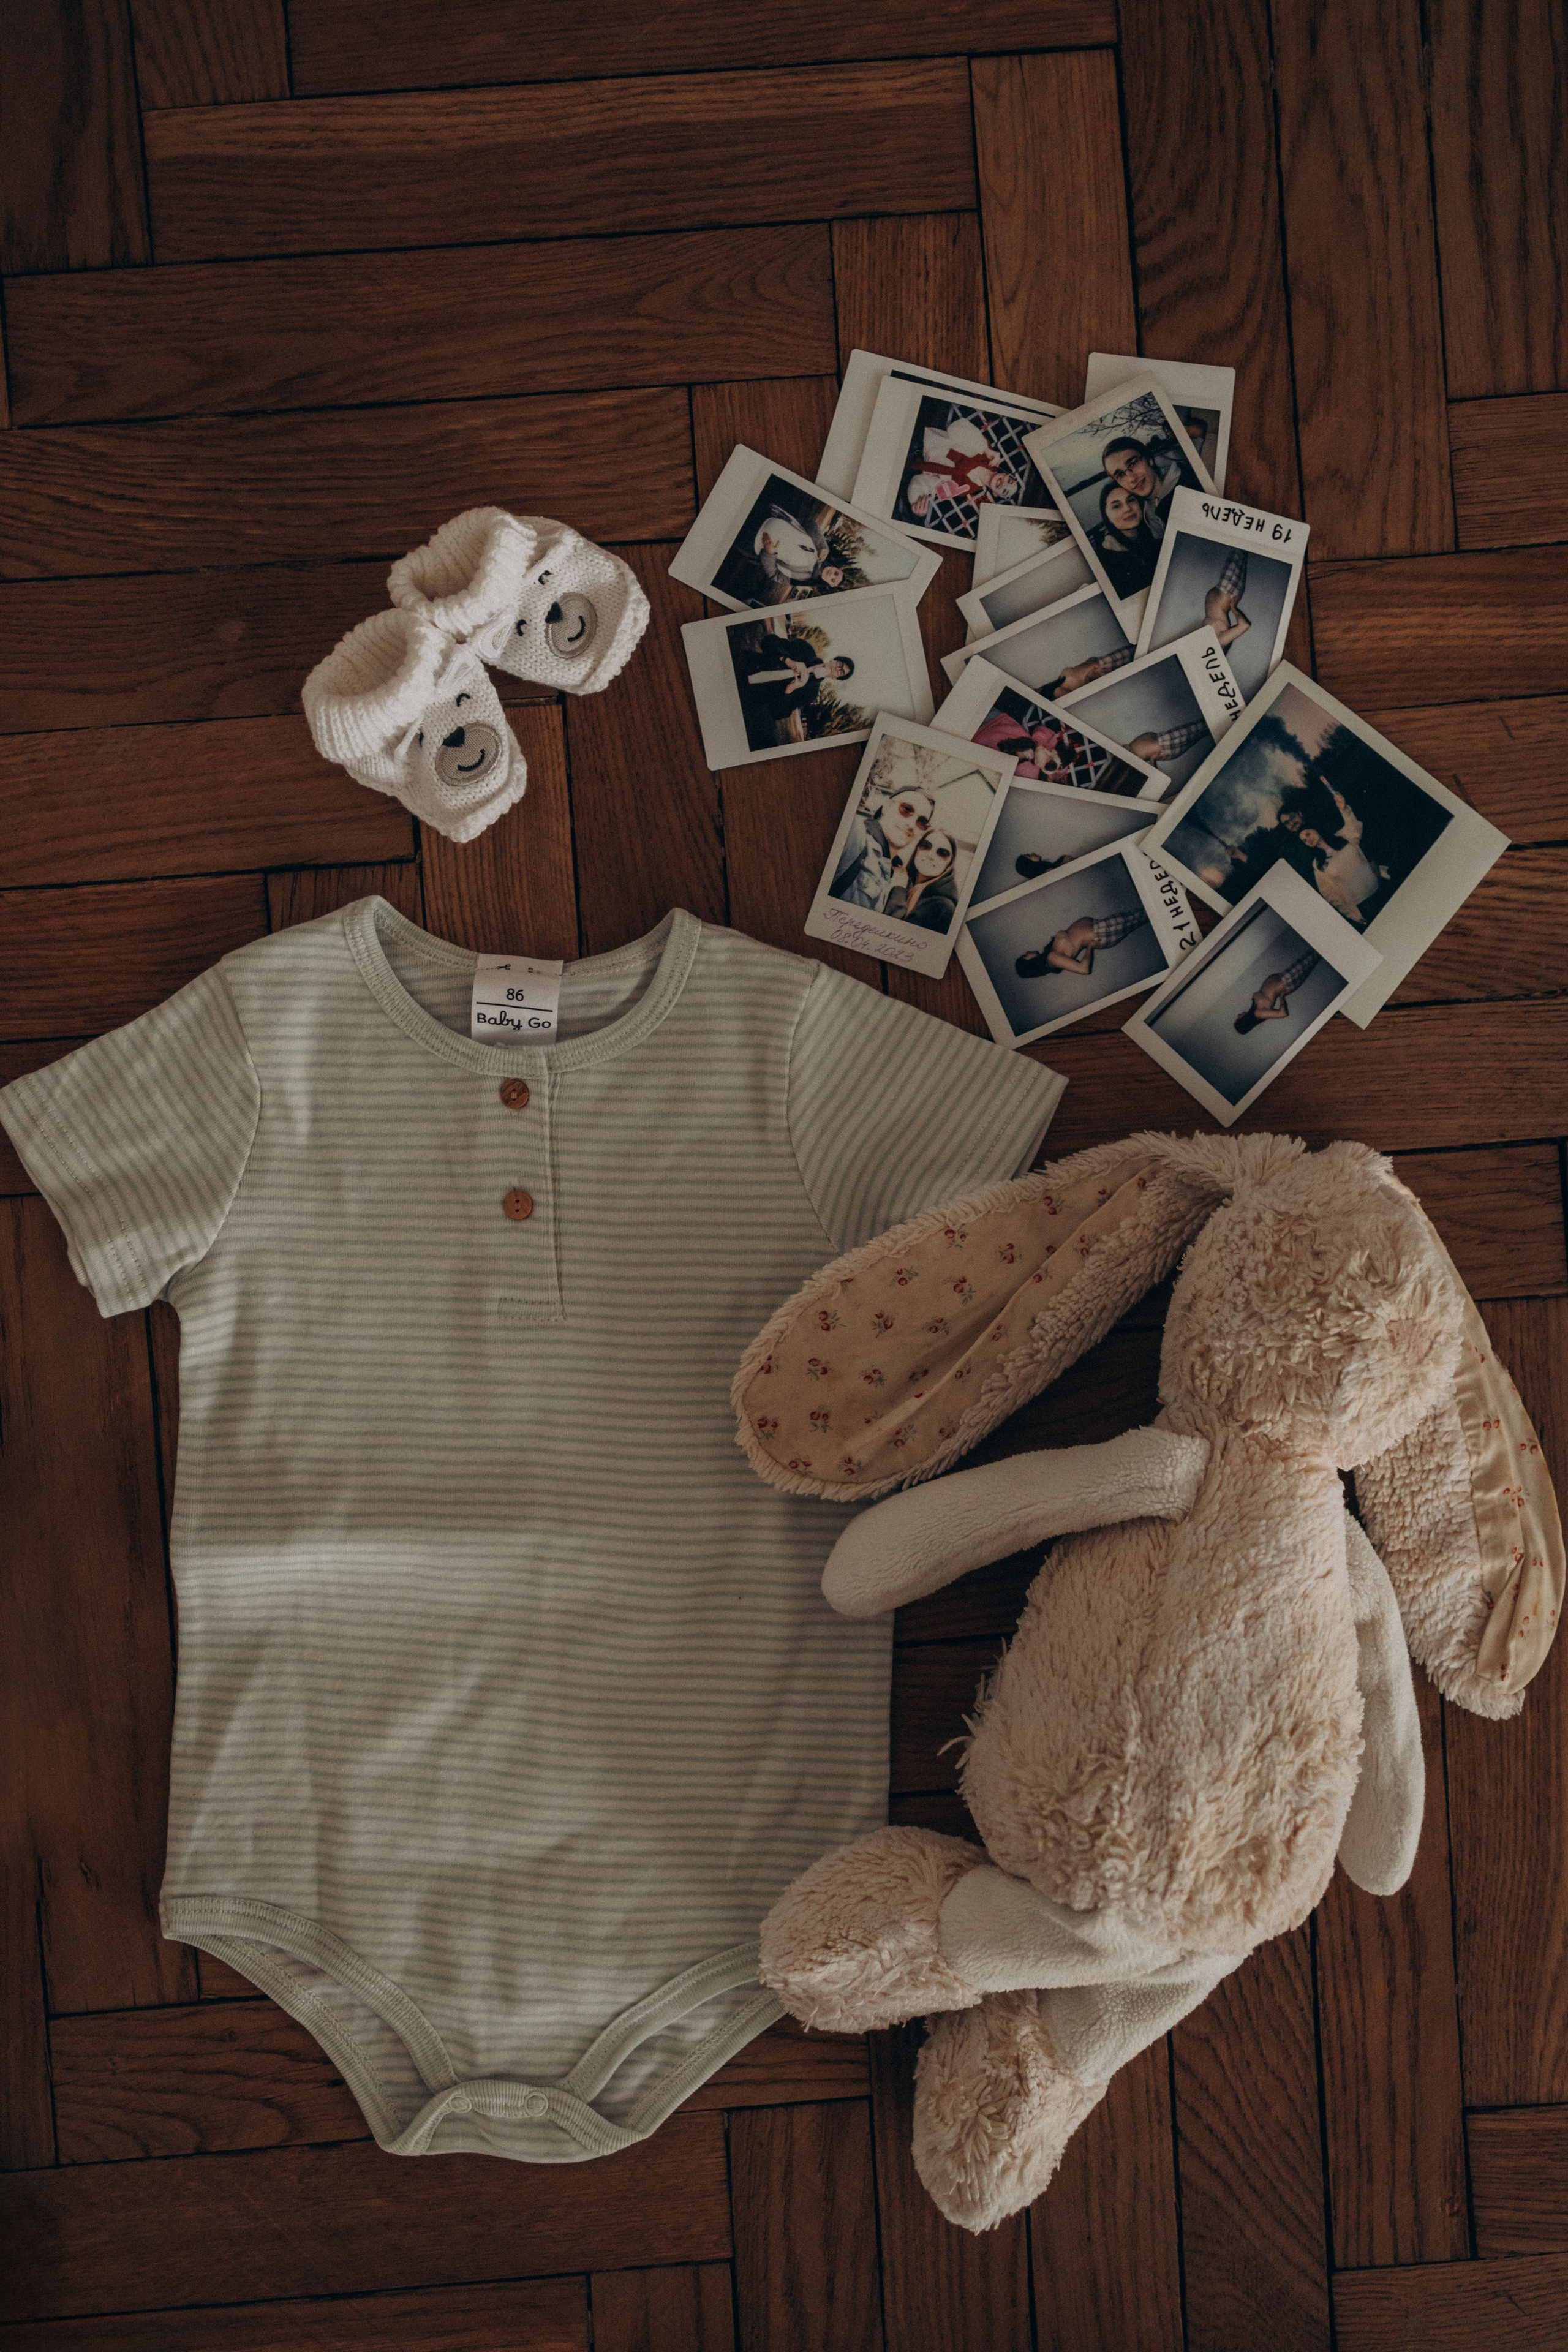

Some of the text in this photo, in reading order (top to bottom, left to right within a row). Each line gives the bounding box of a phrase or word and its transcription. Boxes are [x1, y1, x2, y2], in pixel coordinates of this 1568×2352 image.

[1202, 502, 1291, 543] 19 НЕДЕЛЬ
[1201, 646, 1241, 722] НЕДЕЛЬ
[1143, 852, 1197, 950] 21 НЕДЕЛ
[506, 987, 524, 1001] 86
[477, 1011, 551, 1031] Baby Go
